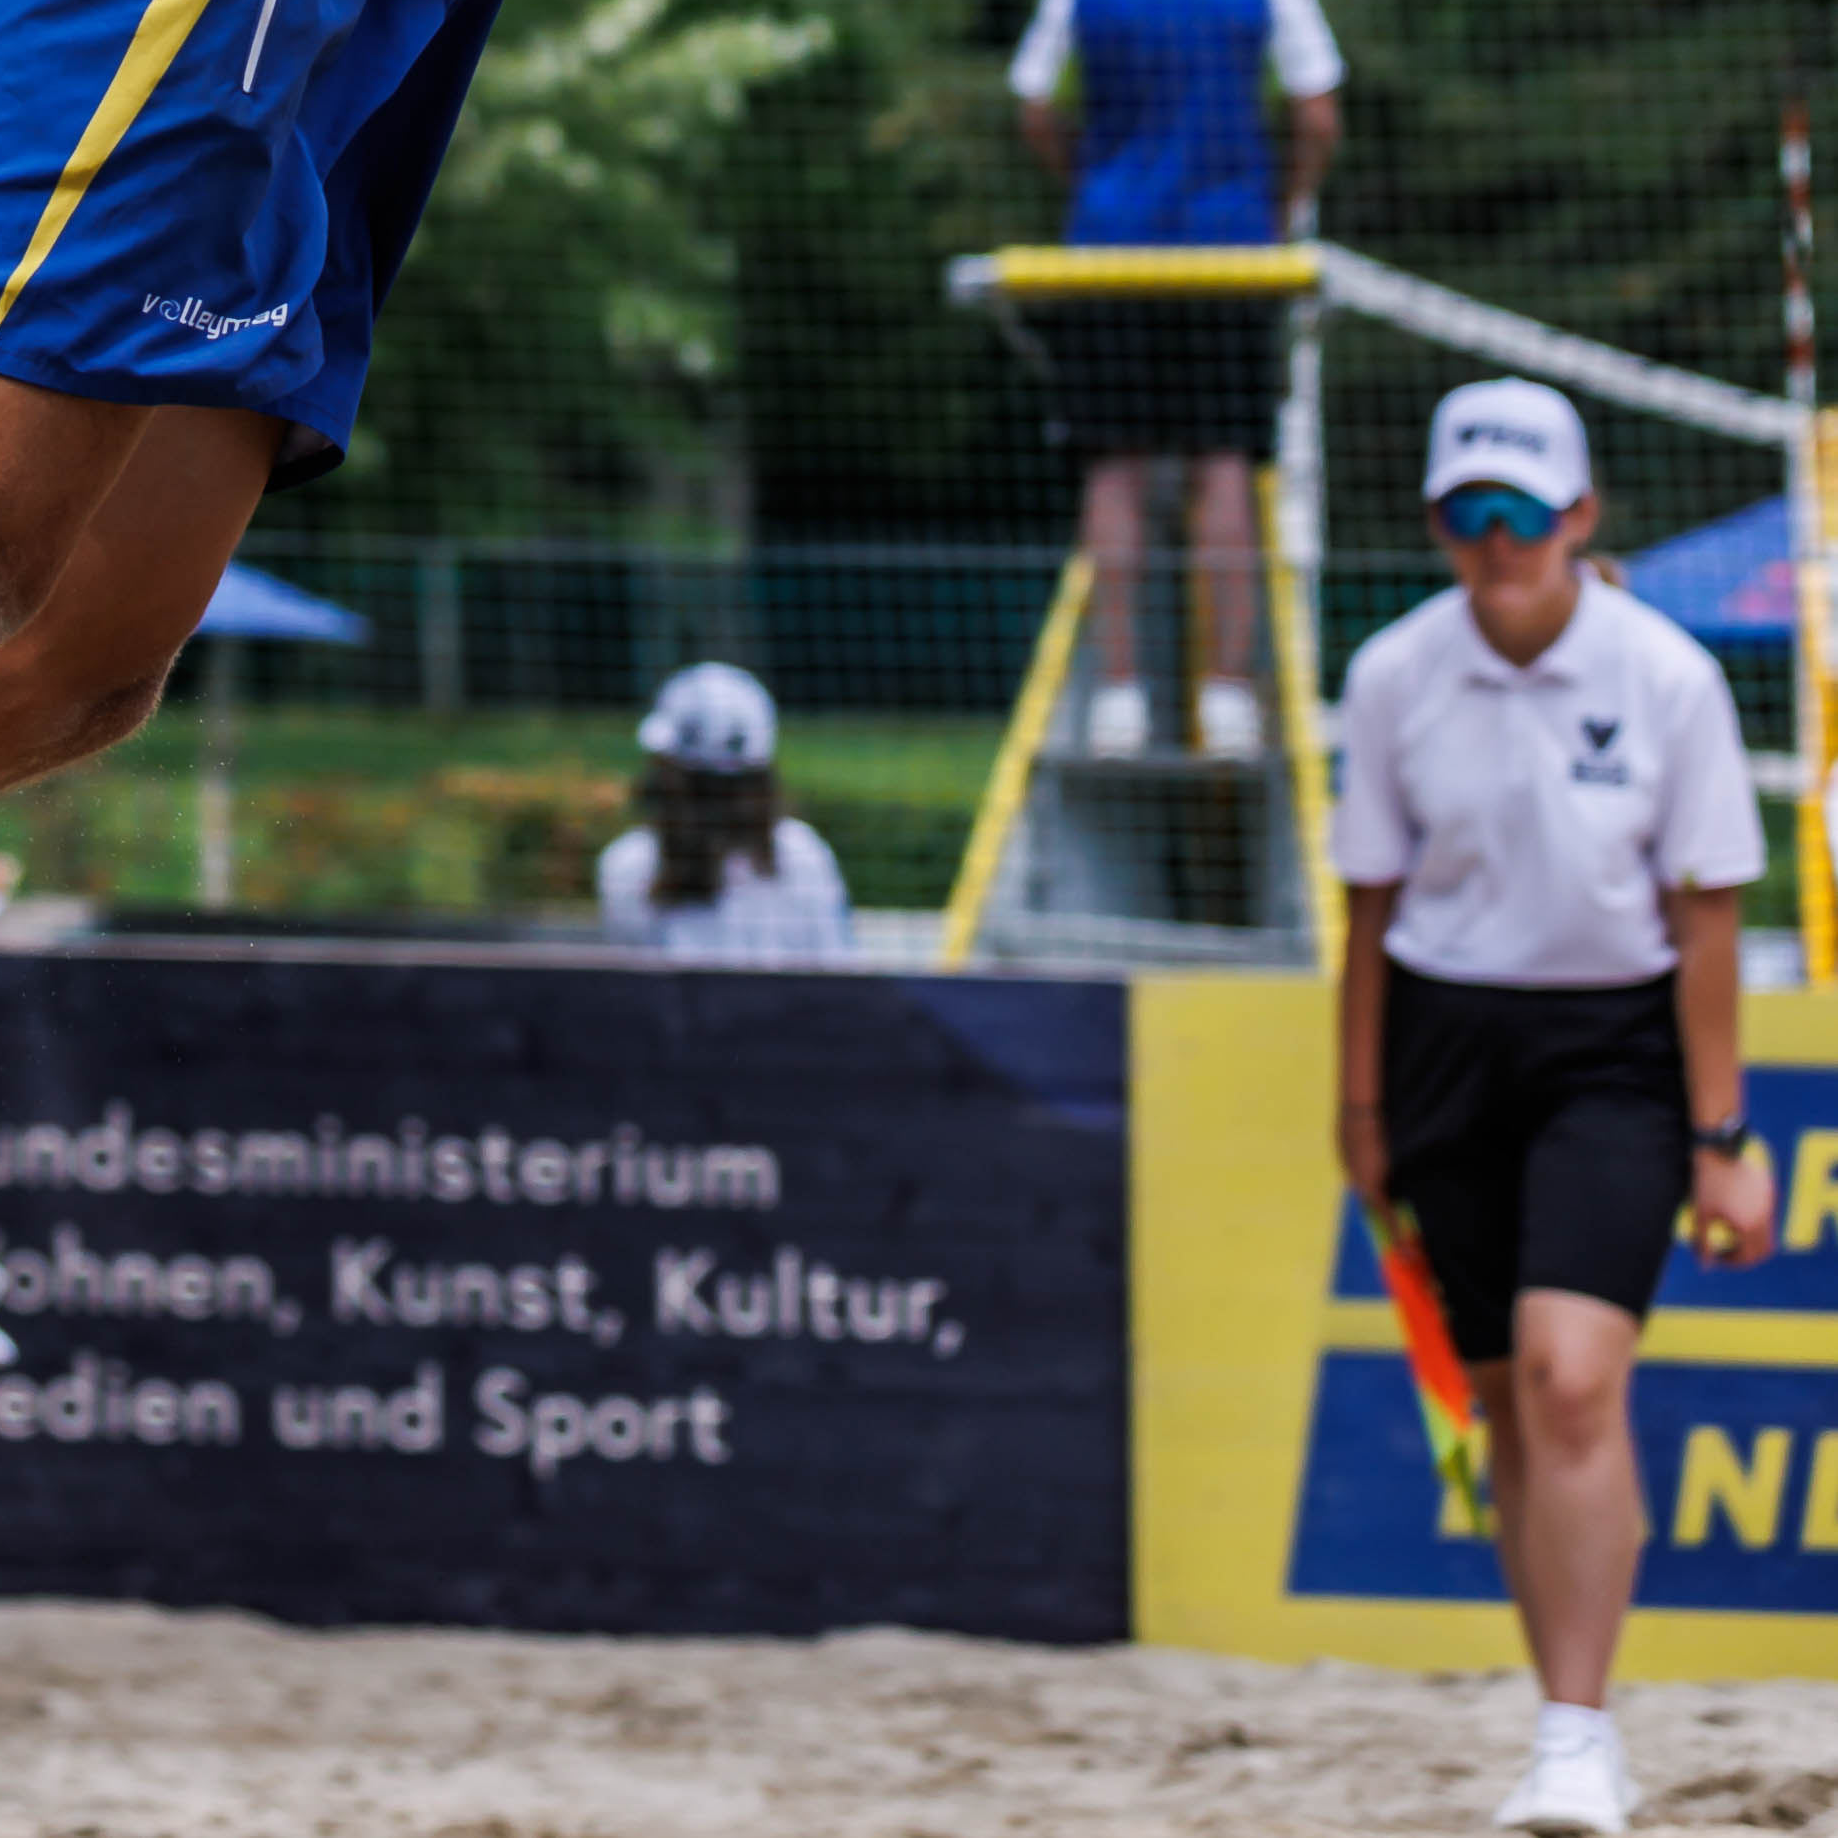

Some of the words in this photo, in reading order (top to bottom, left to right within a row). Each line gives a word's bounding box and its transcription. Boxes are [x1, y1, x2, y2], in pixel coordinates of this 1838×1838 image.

[141, 293, 289, 340] volleymag
[330, 1236, 624, 1346] Kunst,
[654, 1244, 963, 1356] Kultur,
[272, 1358, 445, 1454] und
[472, 1366, 734, 1479] Sport
